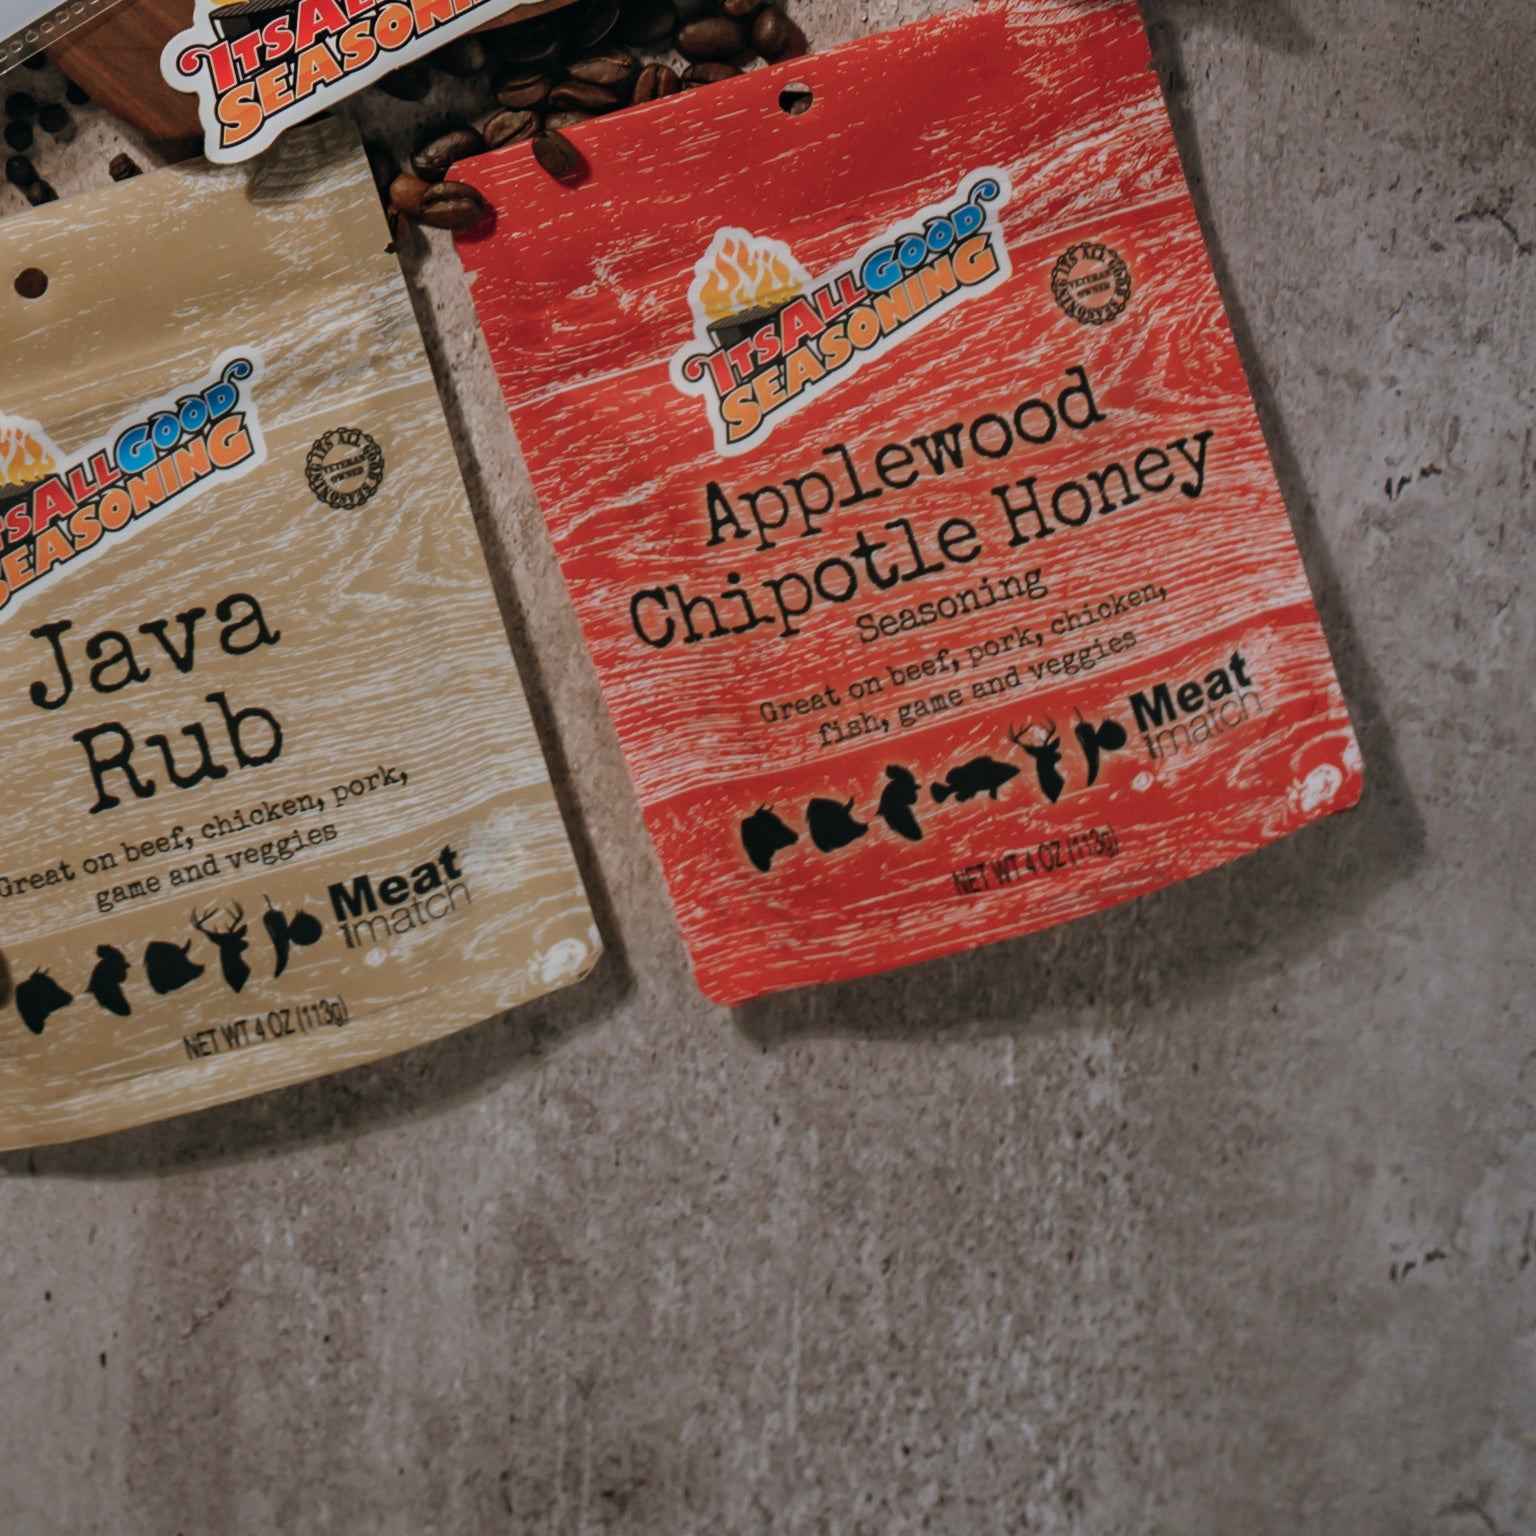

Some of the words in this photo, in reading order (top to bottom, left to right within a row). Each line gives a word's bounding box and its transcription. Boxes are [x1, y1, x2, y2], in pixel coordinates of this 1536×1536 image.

[720, 232, 1001, 445] SEASONING
[705, 364, 1107, 551] Applewood
[629, 517, 982, 649] Chipotle
[990, 429, 1214, 547] Honey
[28, 592, 281, 710] Java
[758, 685, 841, 723] Great
[847, 676, 884, 699] on
[885, 647, 960, 686] beef,
[965, 626, 1043, 668] pork,
[1050, 583, 1167, 635] chicken,
[855, 567, 1048, 644] Seasoning
[817, 711, 890, 747] fish,
[897, 689, 964, 728] game
[971, 664, 1023, 699] and
[1027, 630, 1137, 680] veggies
[1128, 651, 1251, 731] Meat
[71, 691, 283, 814] Rub
[82, 852, 118, 875] on
[119, 825, 194, 862] beef,
[200, 794, 325, 839] chicken,
[330, 765, 408, 807] pork,
[95, 875, 160, 913] game
[168, 852, 221, 886] and
[224, 823, 337, 869] veggies
[327, 844, 462, 922] Meat
[351, 875, 471, 947] match
[182, 1027, 219, 1060] NET
[219, 1019, 247, 1049] WT
[255, 1017, 266, 1040] 4
[266, 1008, 295, 1038] OZ
[295, 999, 348, 1032] (113g)
